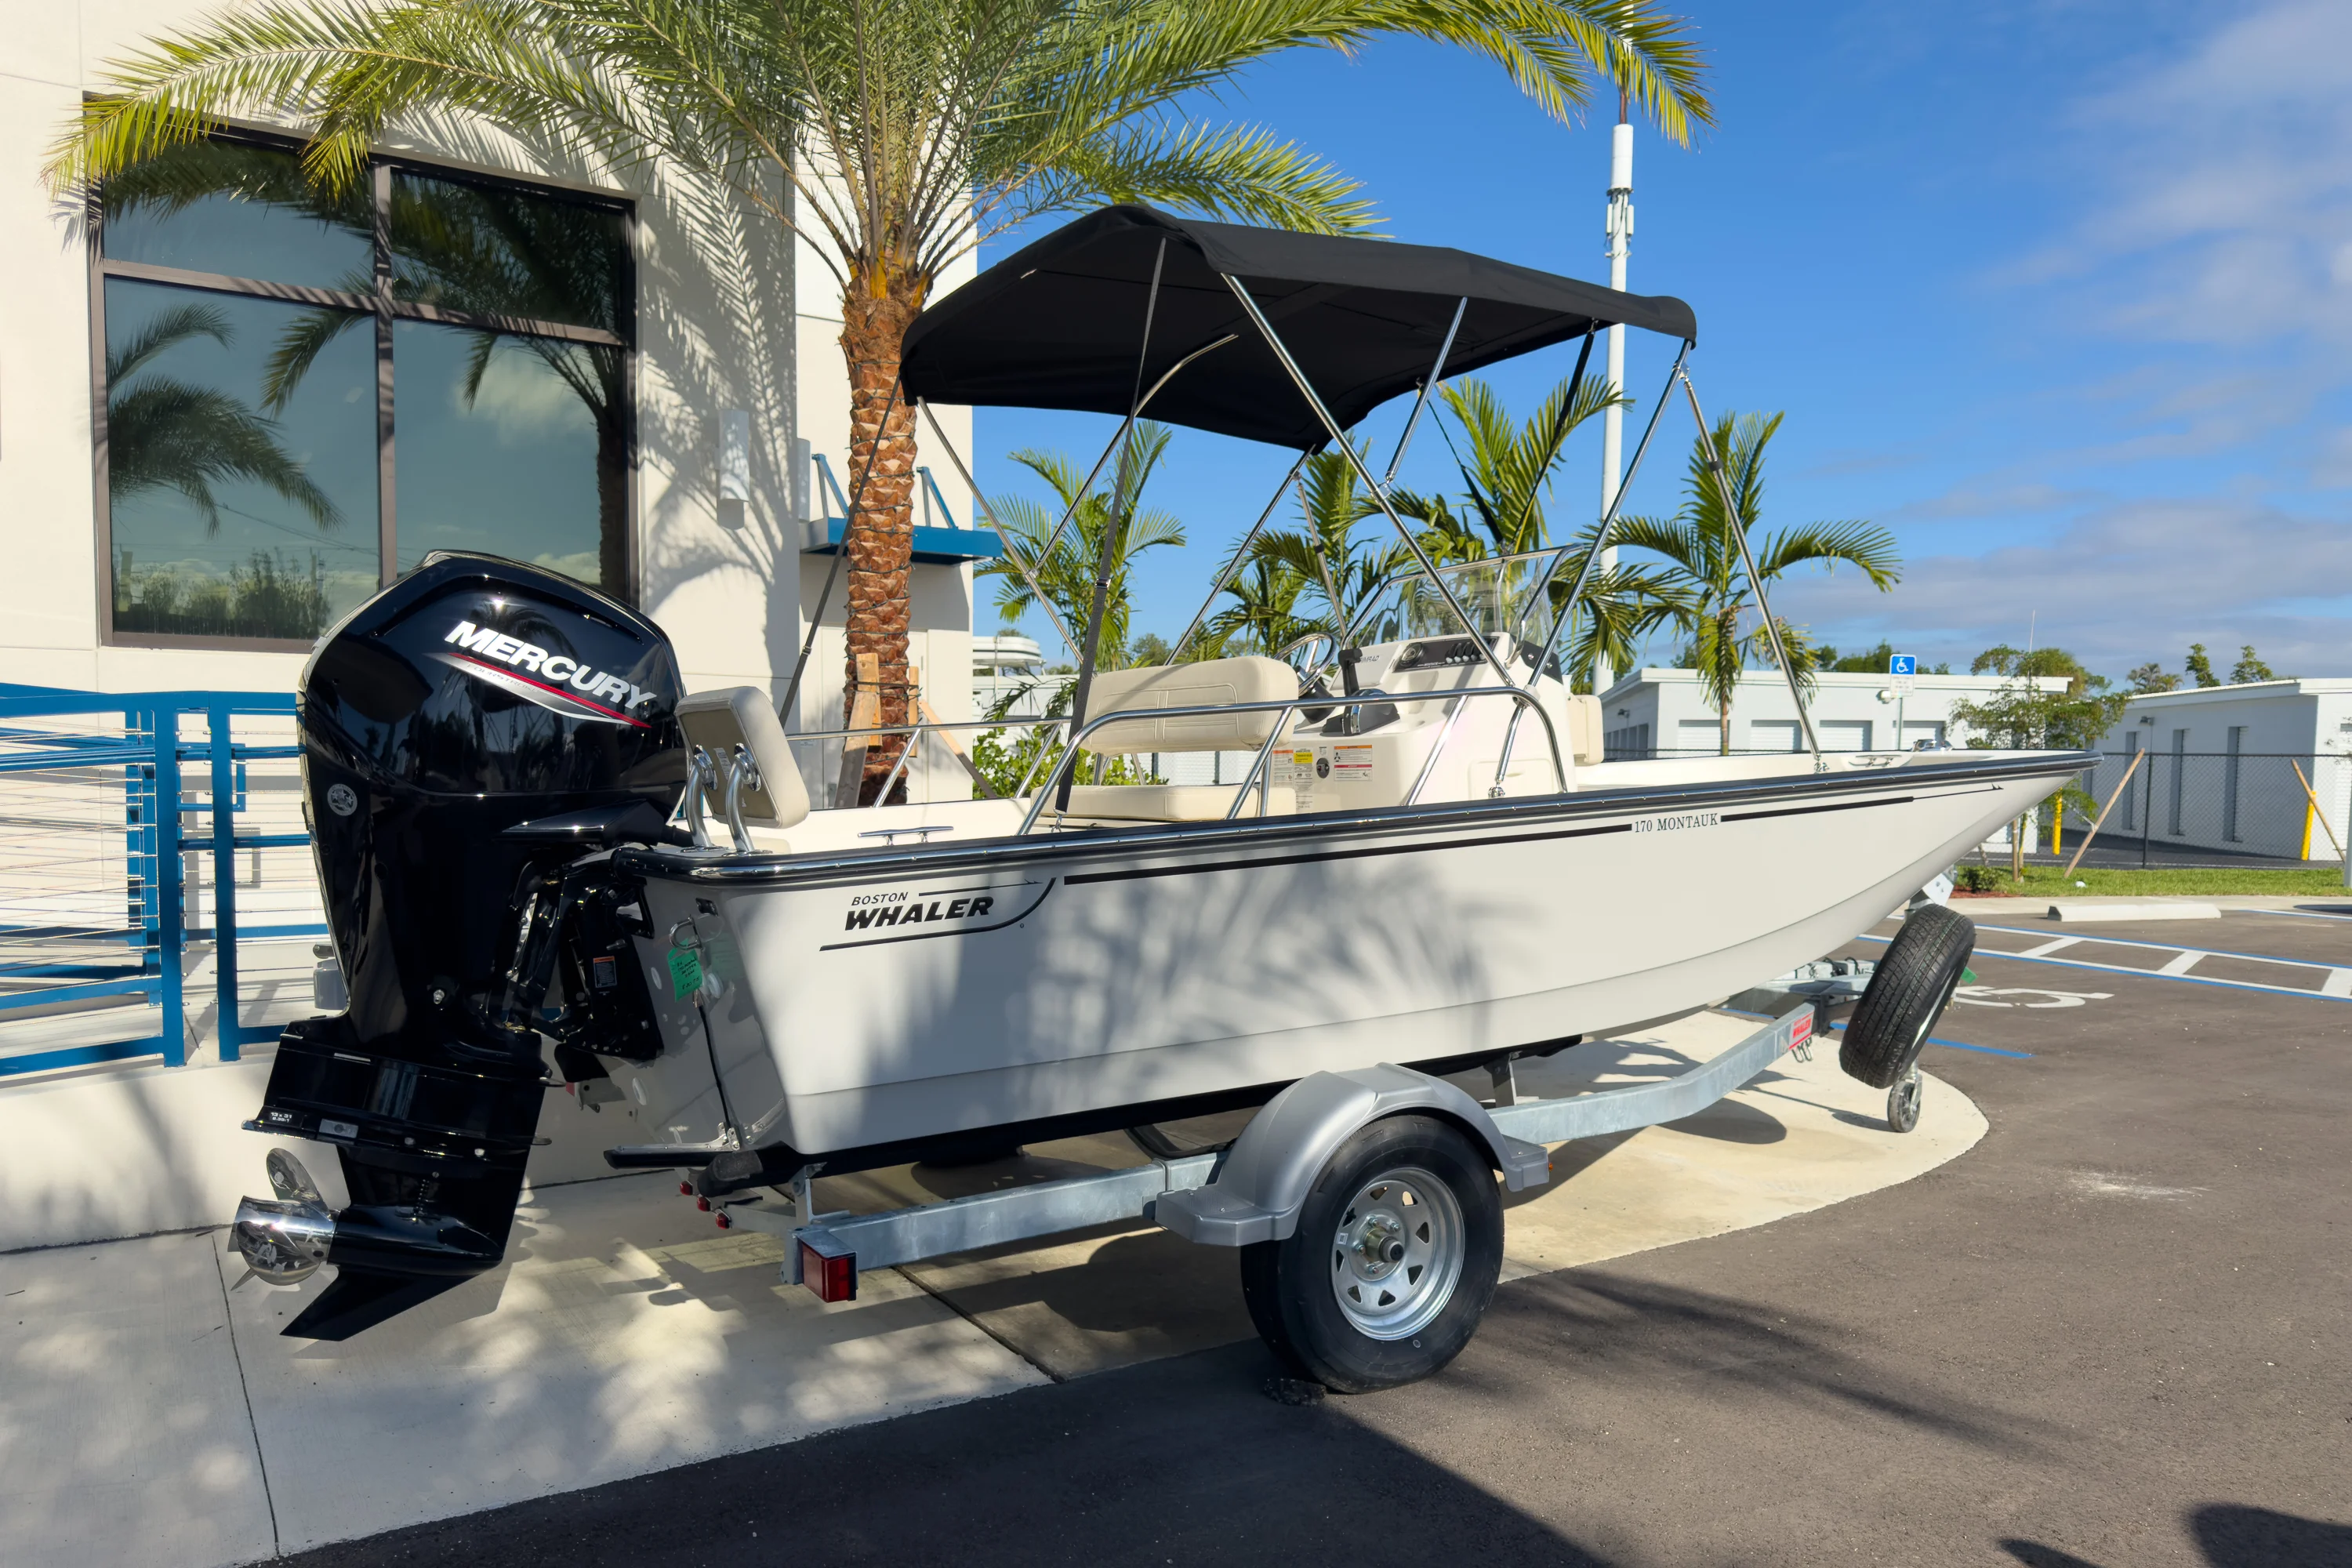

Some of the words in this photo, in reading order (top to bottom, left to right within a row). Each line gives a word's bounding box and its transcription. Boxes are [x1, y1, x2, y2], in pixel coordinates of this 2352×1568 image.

[445, 621, 657, 710] MERCURY
[1635, 819, 1653, 833] 170
[1657, 813, 1719, 831] MONTAUK
[851, 891, 908, 906] BOSTON
[844, 896, 994, 931] WHALER
